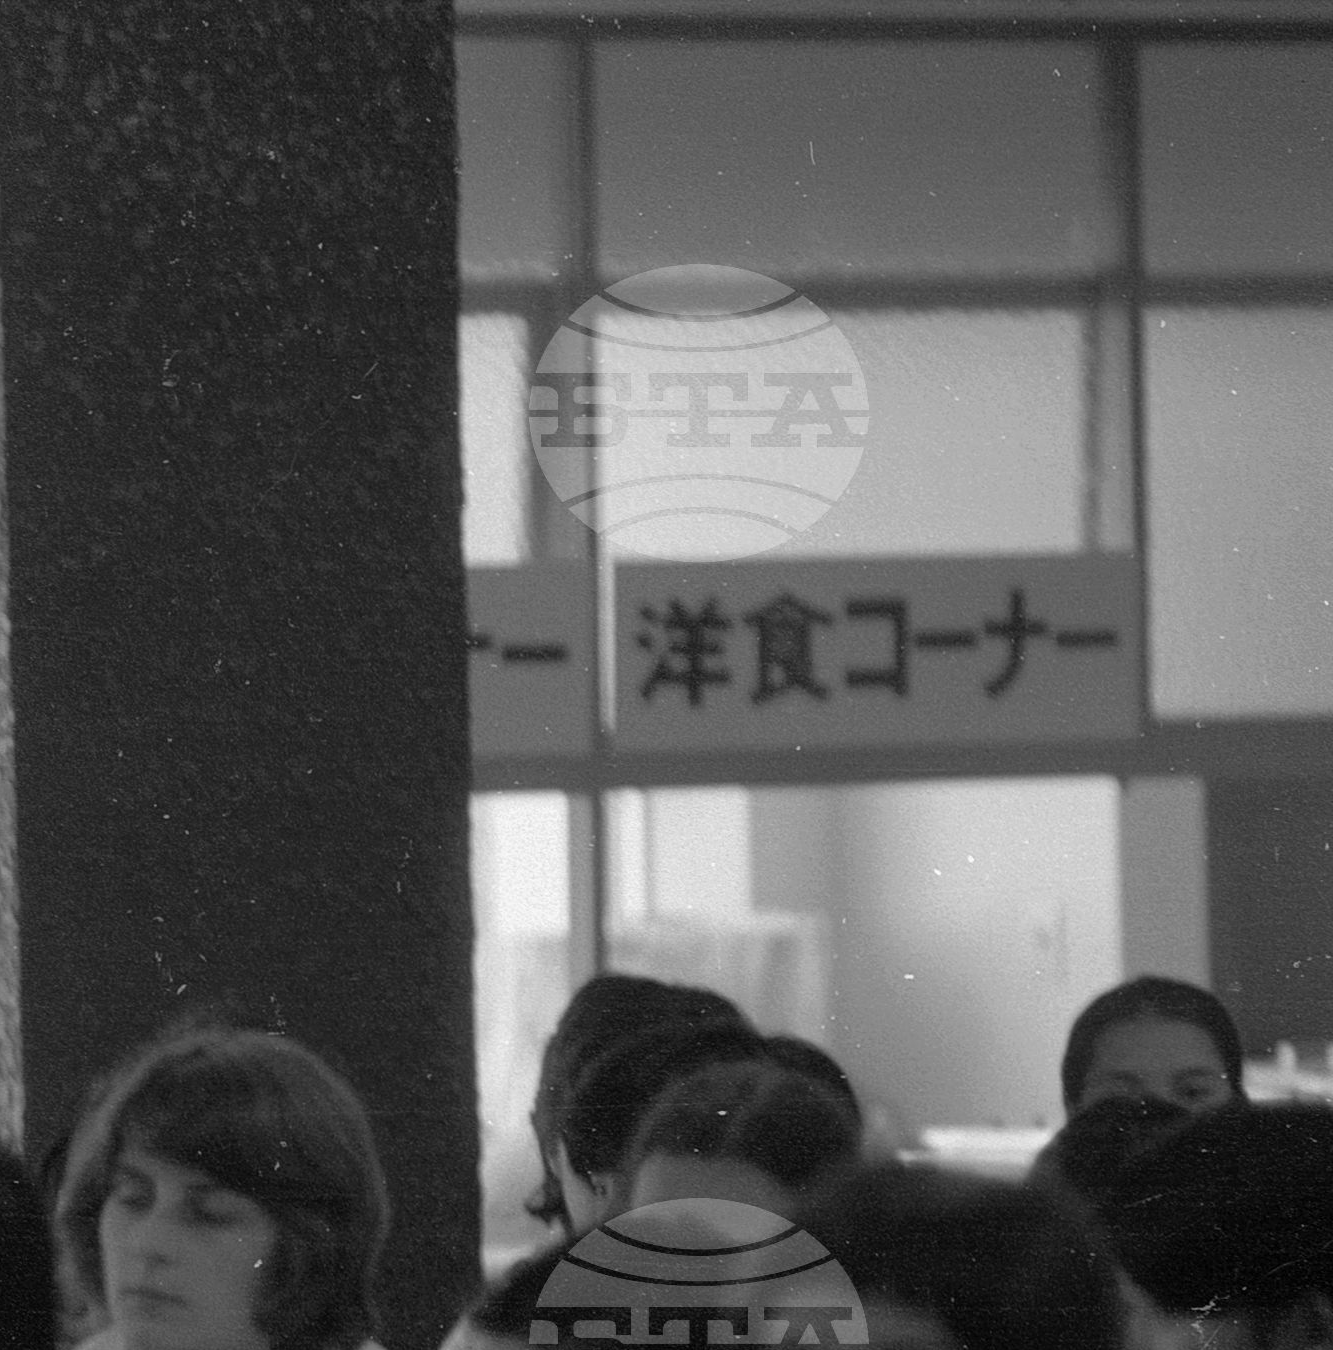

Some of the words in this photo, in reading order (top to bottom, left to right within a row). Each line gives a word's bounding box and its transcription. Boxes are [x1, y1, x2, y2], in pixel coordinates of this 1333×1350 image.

[635, 588, 1119, 704] 洋食コーナー
